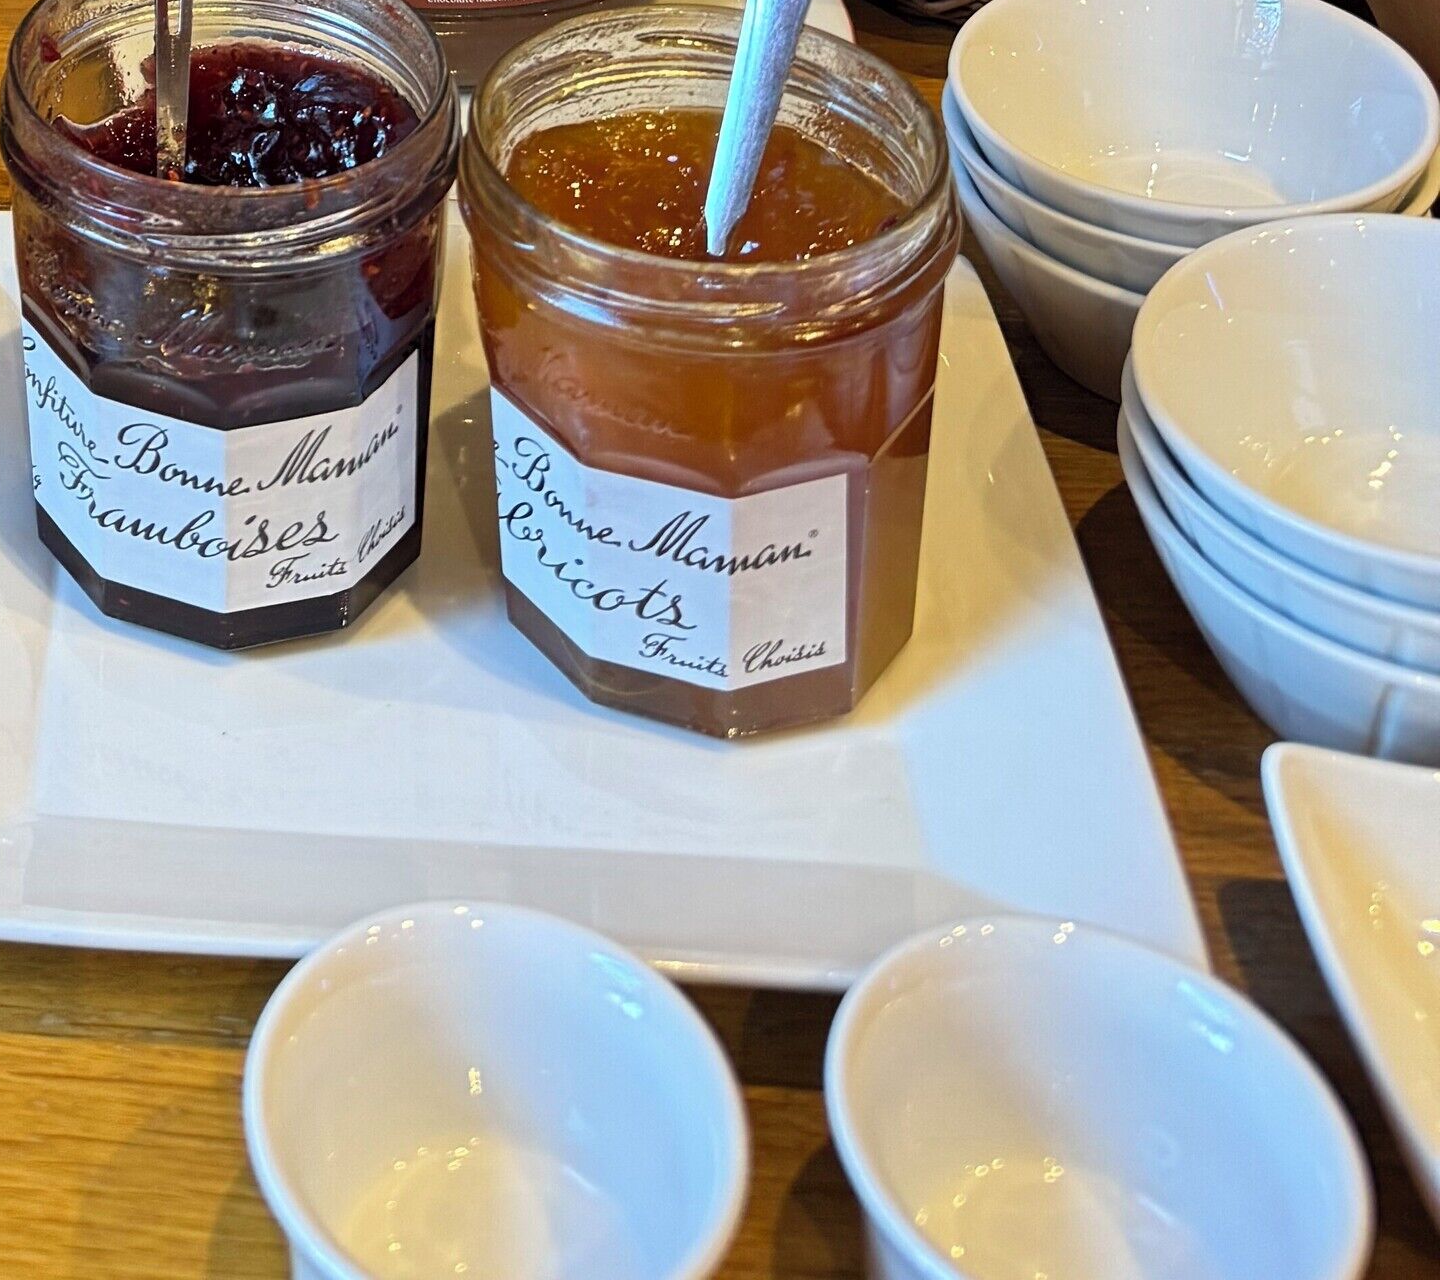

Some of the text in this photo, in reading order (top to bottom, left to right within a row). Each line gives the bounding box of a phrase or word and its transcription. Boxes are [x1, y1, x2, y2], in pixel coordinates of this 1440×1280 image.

[114, 422, 251, 497] Bonne
[512, 436, 622, 547] Bonne
[58, 441, 339, 562] Framboises
[266, 552, 348, 588] Fruits
[638, 632, 827, 678] Fruits Choisis
